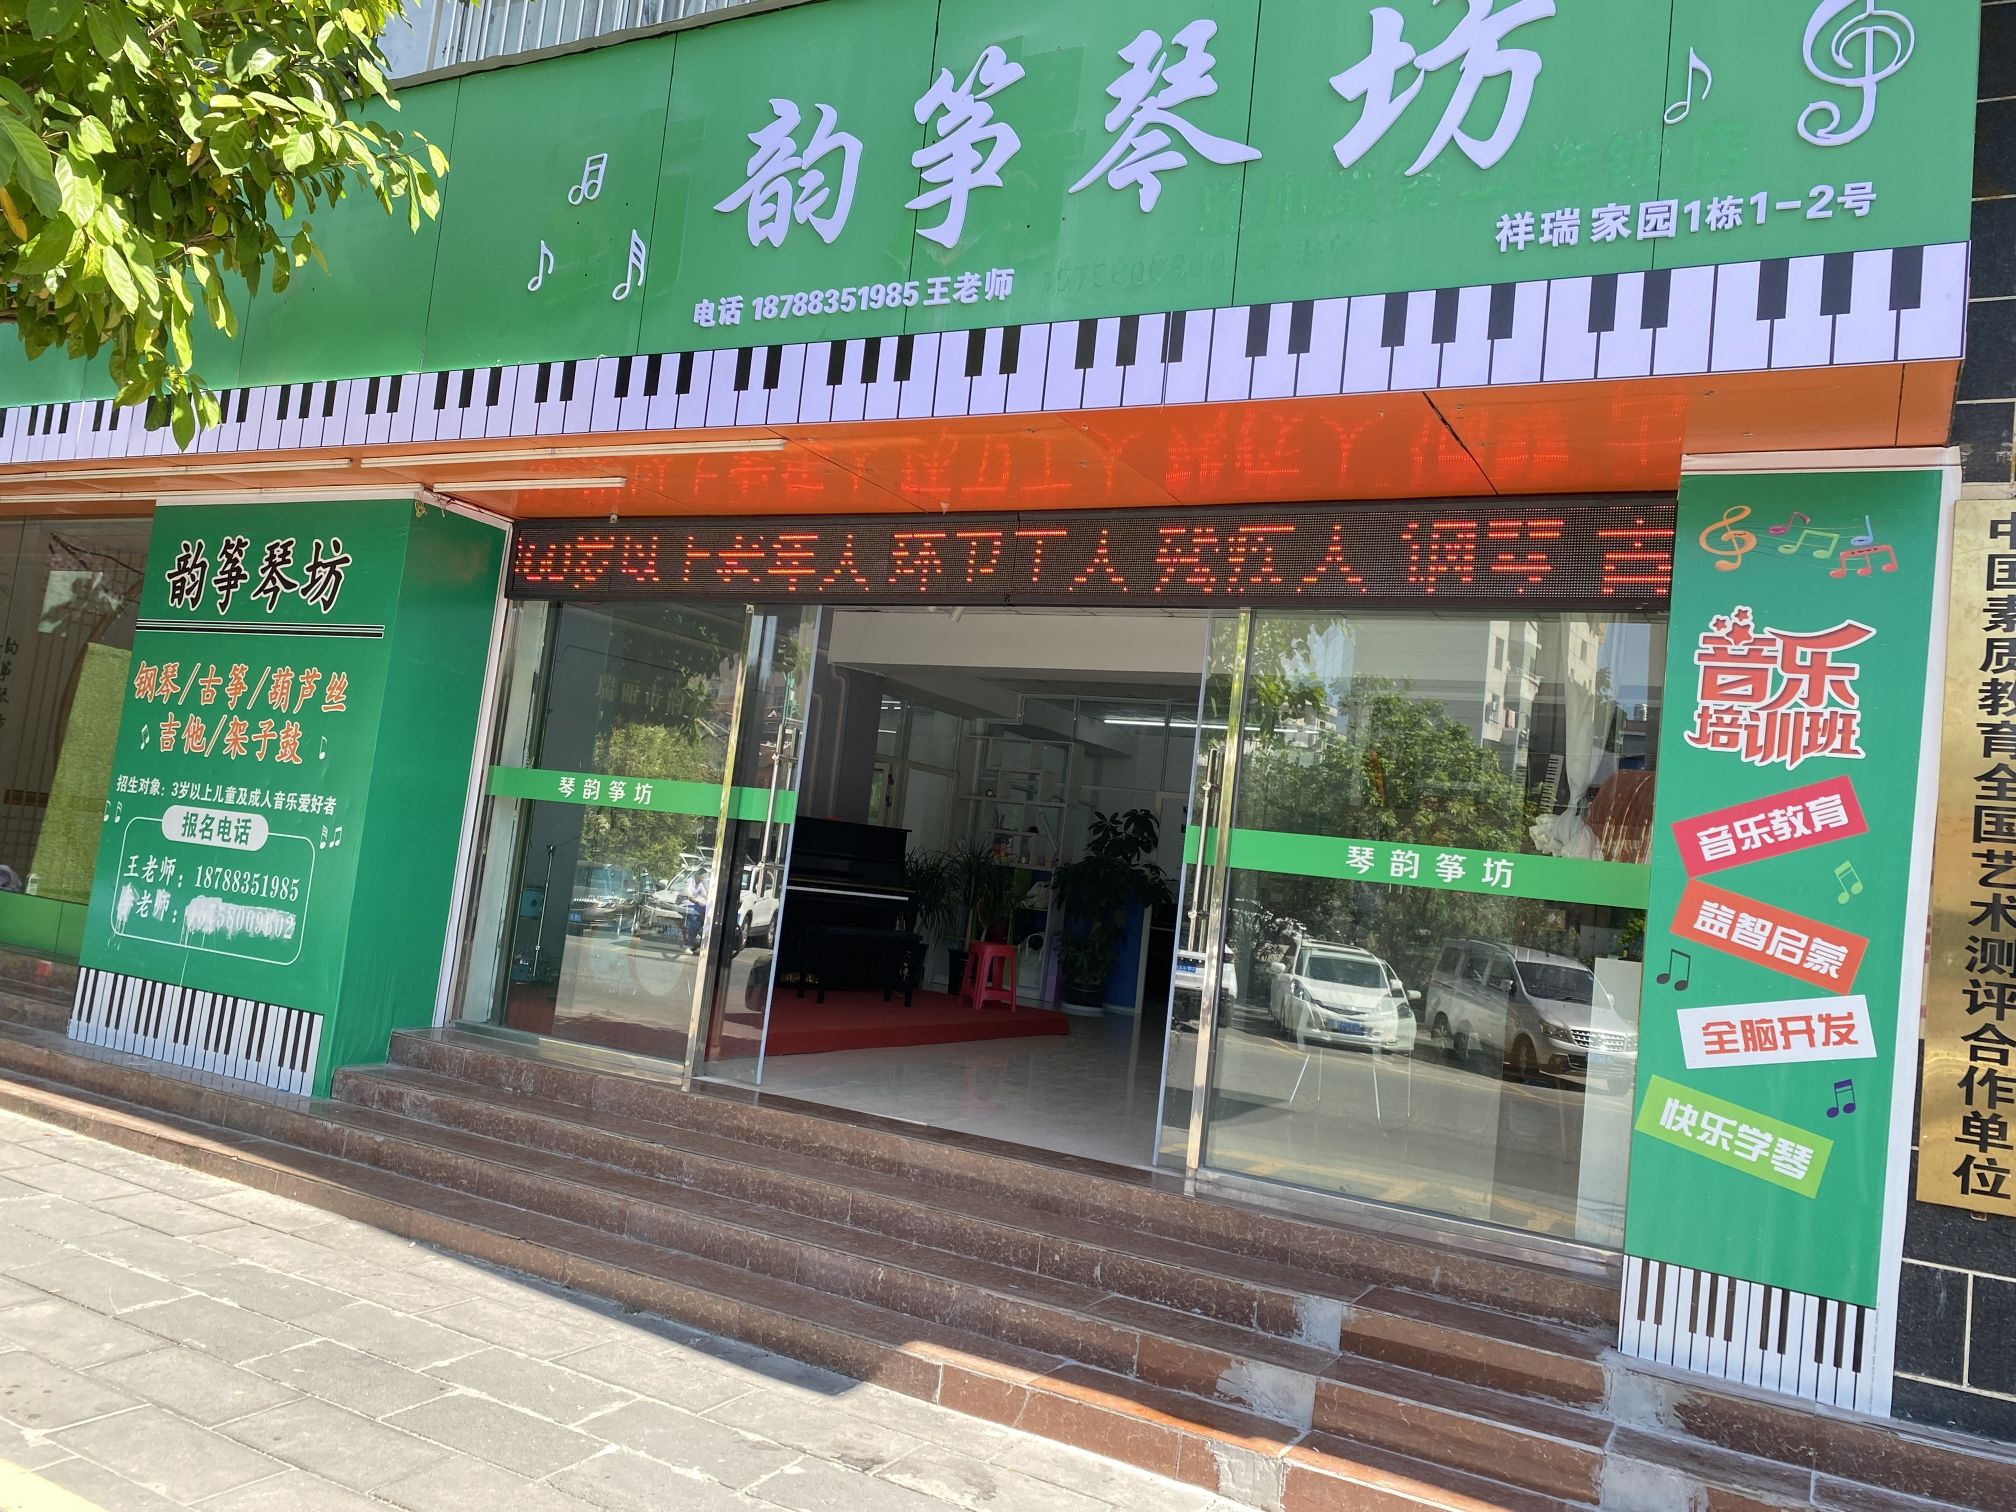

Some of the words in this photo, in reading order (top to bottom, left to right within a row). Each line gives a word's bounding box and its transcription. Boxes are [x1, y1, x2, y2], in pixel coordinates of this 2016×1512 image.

[712, 0, 1556, 249] 韵筝琴坊
[693, 294, 743, 329] 电话
[751, 279, 919, 322] 18788351985
[924, 266, 1016, 307] 王老师
[165, 535, 353, 615] 韵筝琴坊
[133, 660, 349, 714] 钢琴/古筝/葫芦丝
[1694, 618, 1877, 711] 音乐
[159, 711, 303, 765] 吉他/架子鼓
[1683, 704, 1867, 770] 培训班
[557, 775, 654, 806] 琴韵筝坊
[181, 810, 253, 846] 报名电话
[1696, 793, 1850, 863] 音乐教育
[1345, 844, 1516, 889] 琴韵筝坊
[1692, 899, 1849, 980] 益智启蒙
[1701, 1011, 1859, 1056] 全脑开发
[1659, 1097, 1815, 1181] 快乐学琴
